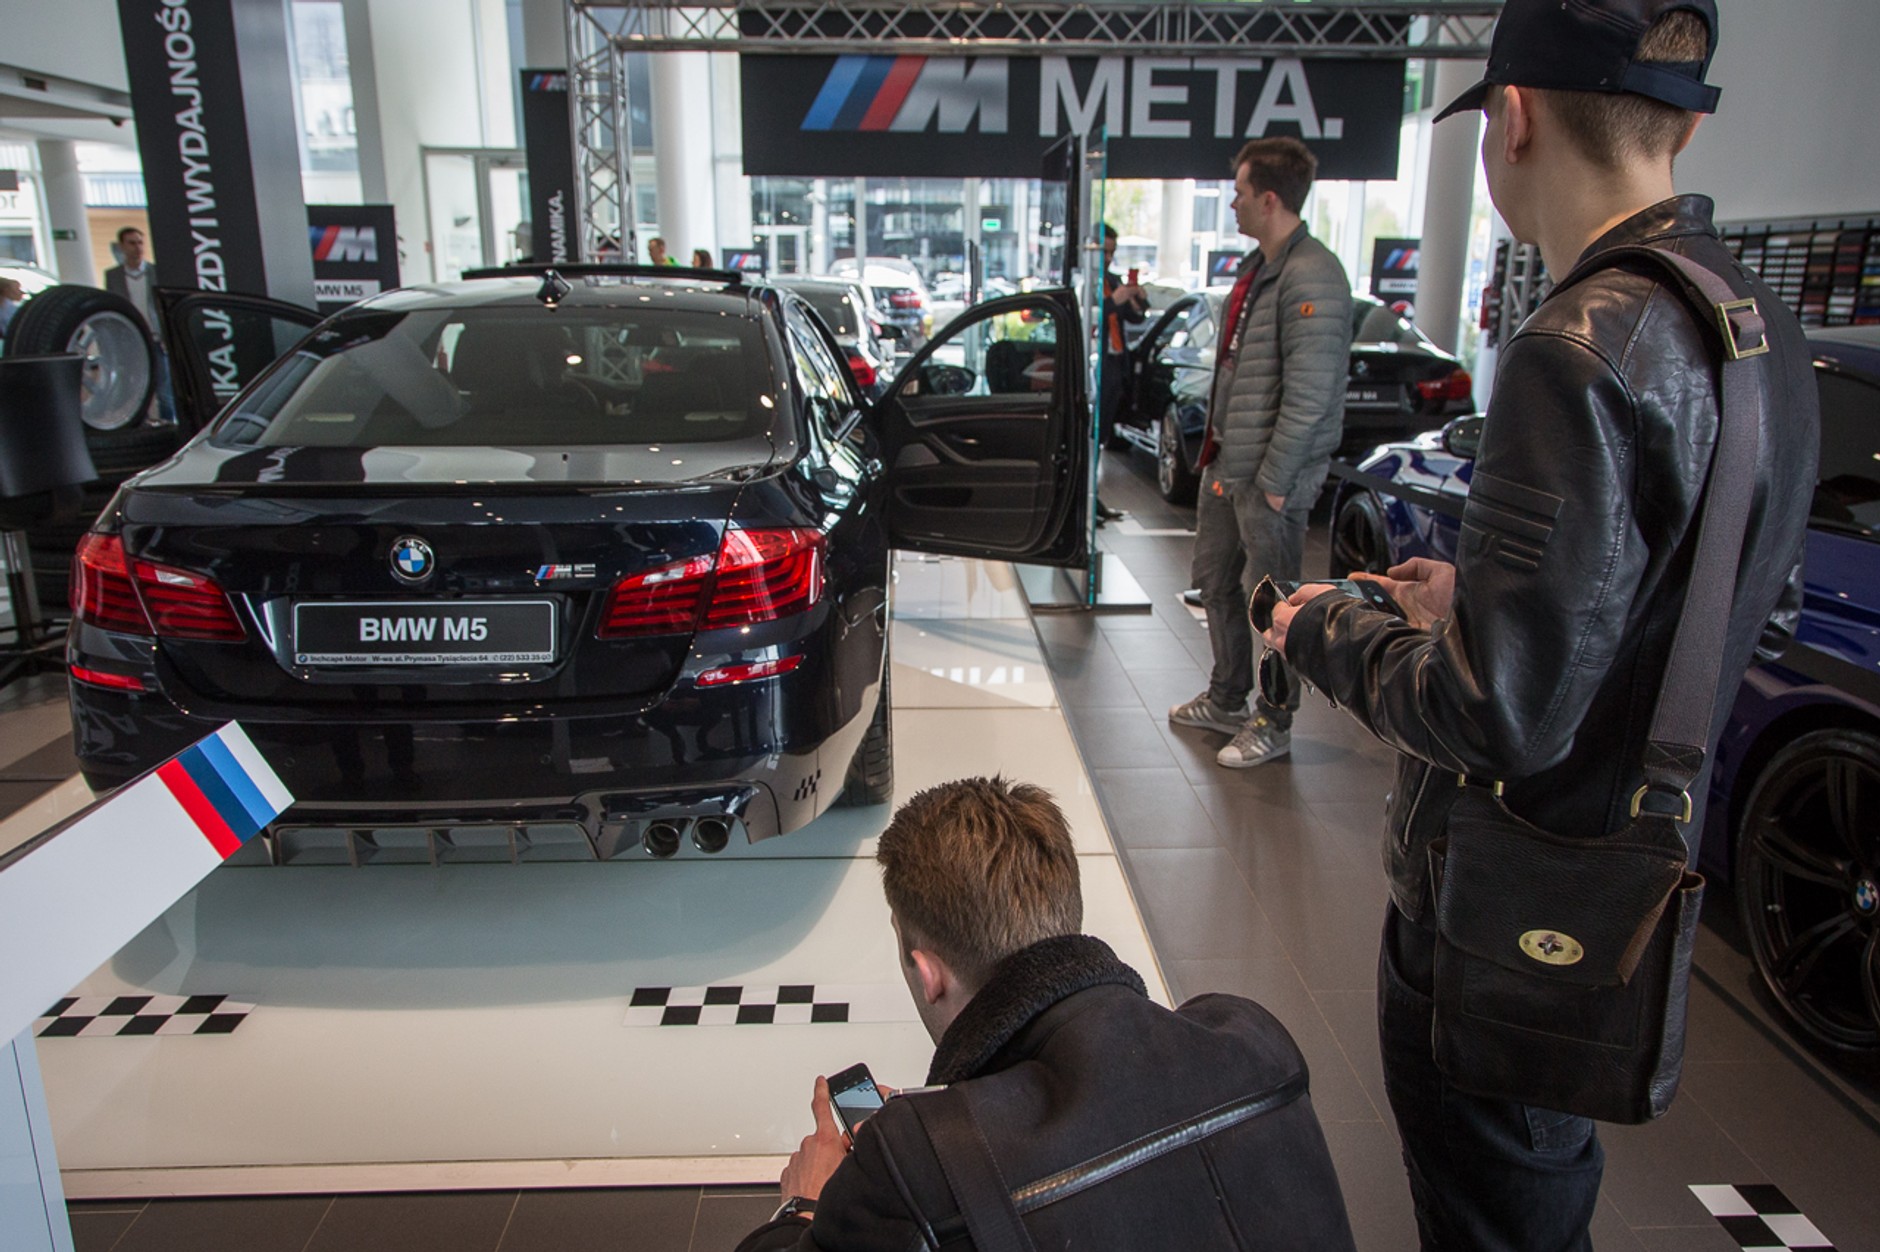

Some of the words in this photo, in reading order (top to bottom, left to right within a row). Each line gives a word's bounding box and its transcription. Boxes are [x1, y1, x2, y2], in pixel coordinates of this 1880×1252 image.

[154, 0, 217, 213] WYDAJNOŚ
[1039, 56, 1344, 138] META.
[189, 217, 219, 228] I
[359, 617, 437, 642] BMW
[442, 617, 488, 641] M5
[310, 655, 344, 663] Inchcape
[404, 654, 436, 663] Prymasa
